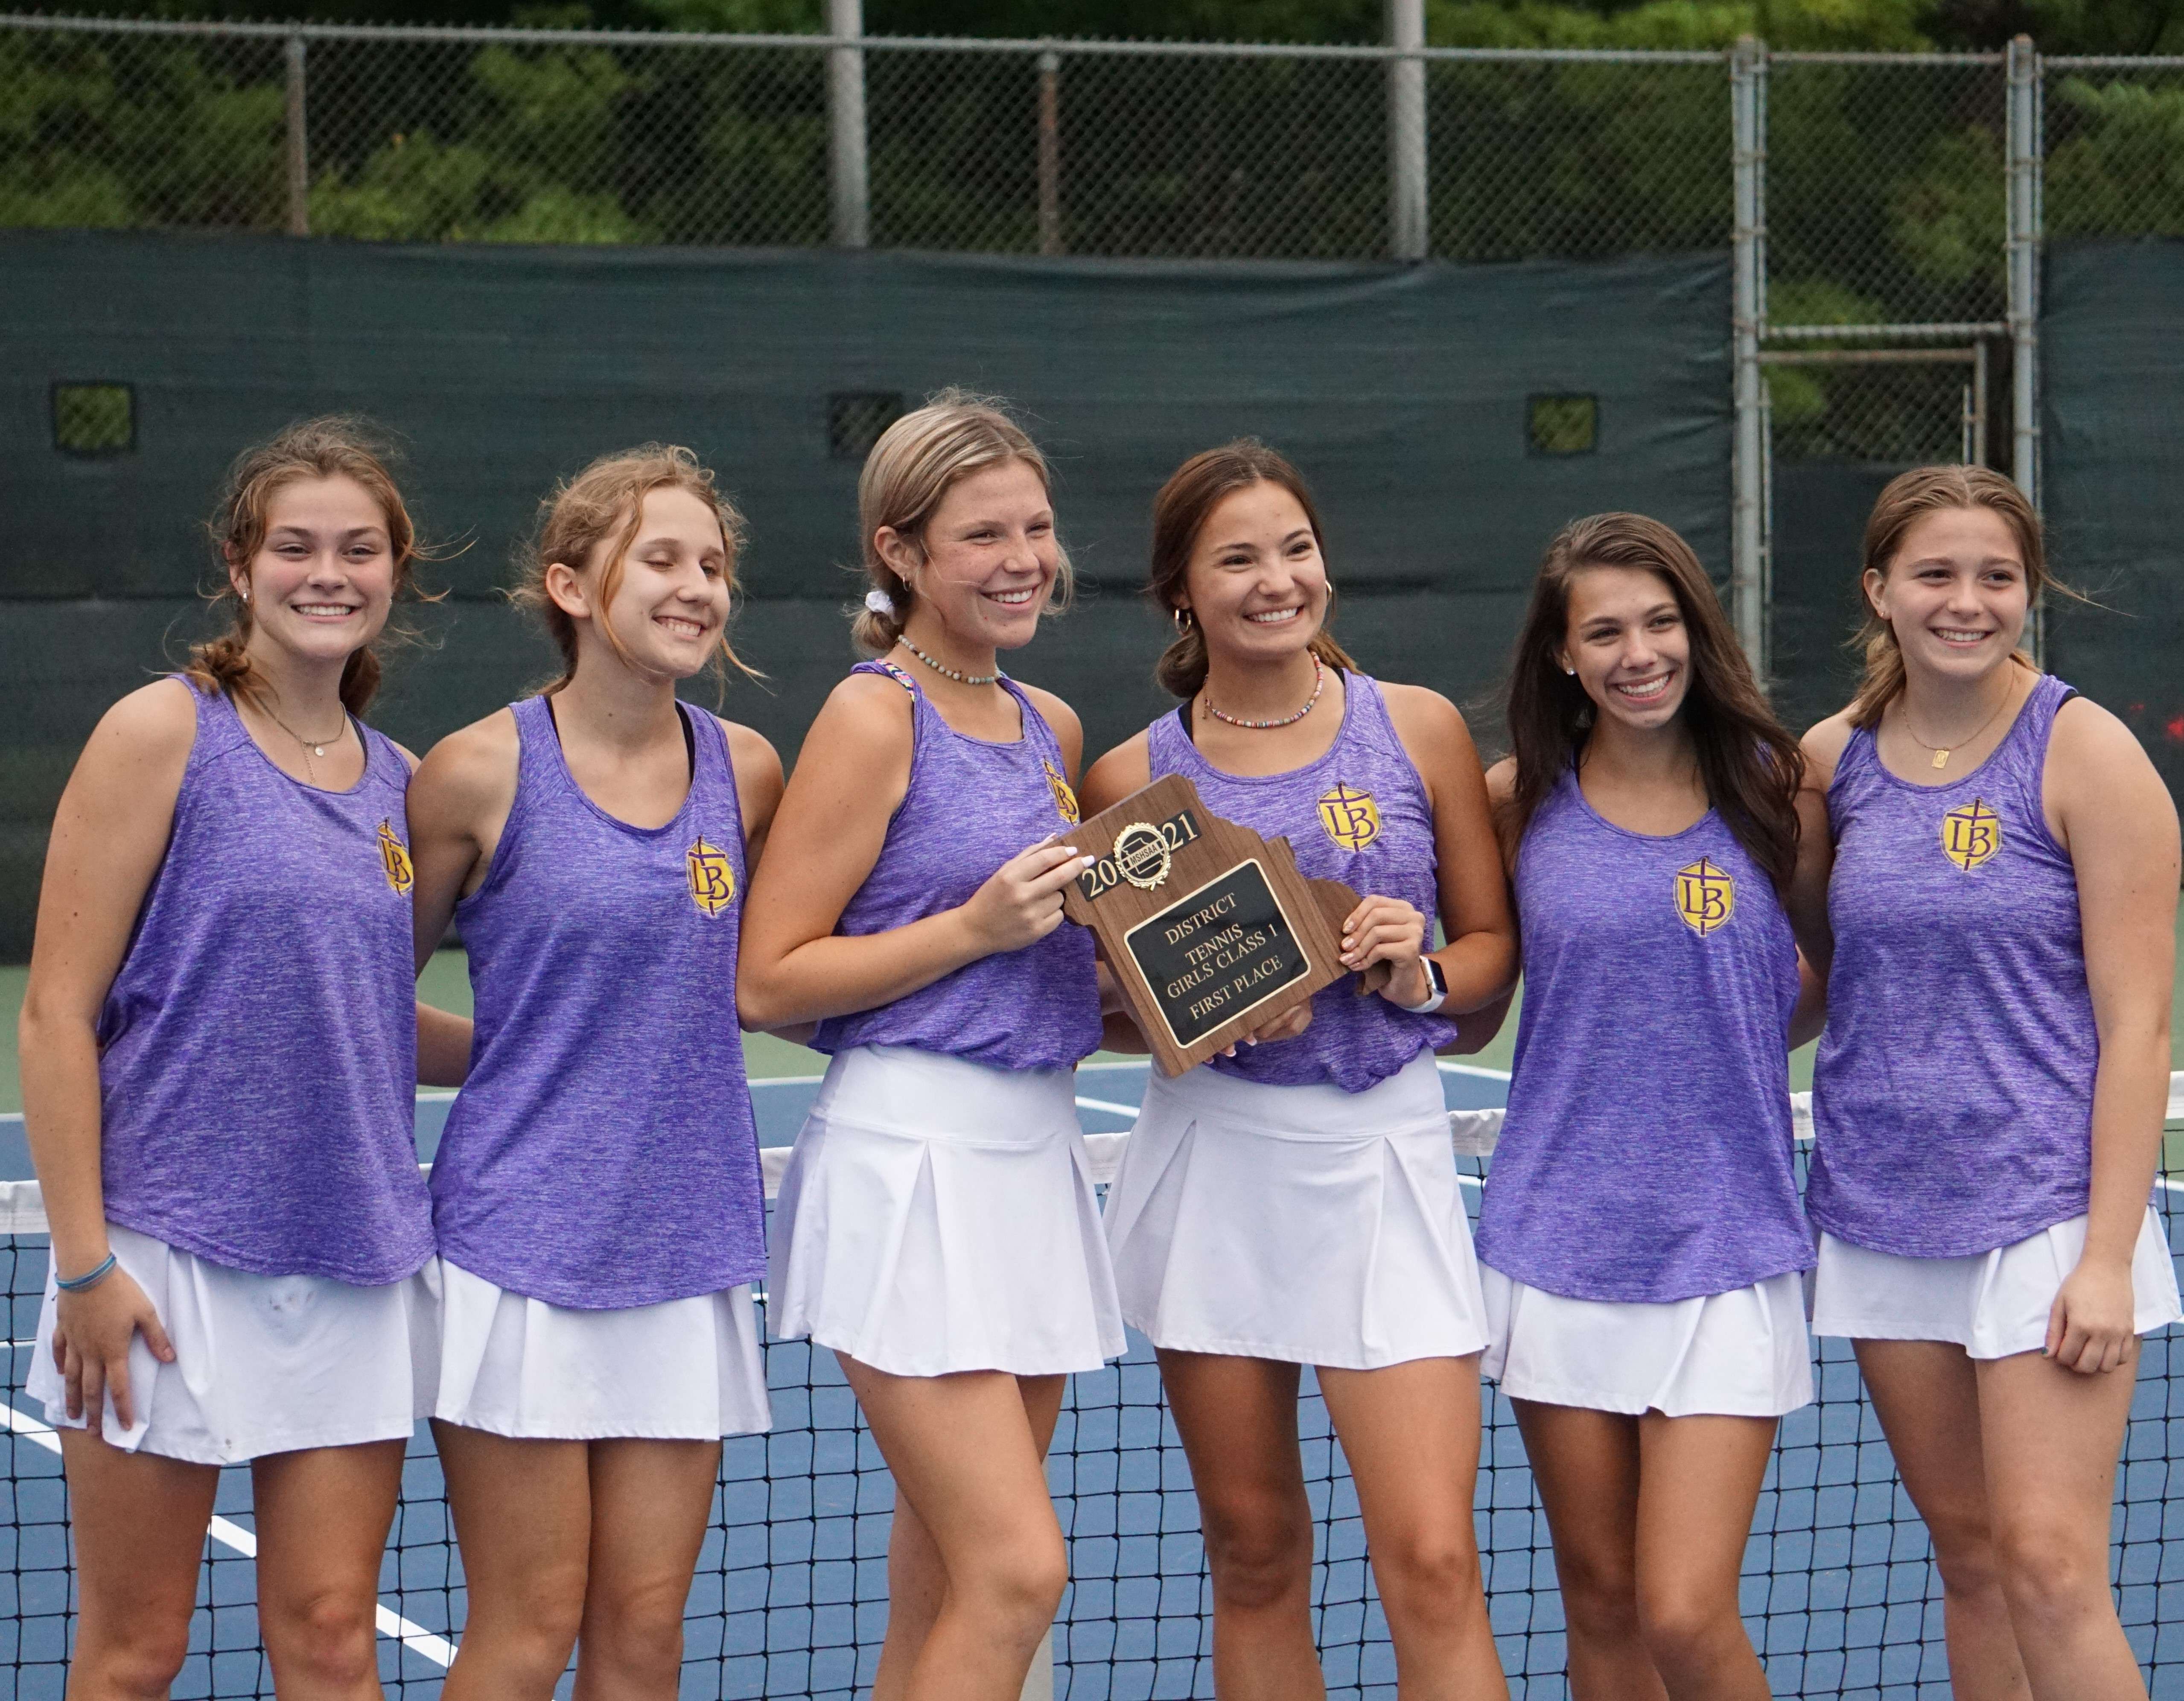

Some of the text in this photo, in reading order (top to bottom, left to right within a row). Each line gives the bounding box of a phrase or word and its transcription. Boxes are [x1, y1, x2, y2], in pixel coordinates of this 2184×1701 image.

[1162, 814, 1198, 851] 21
[1325, 805, 1375, 840] LB
[1949, 820, 1991, 858] LB
[1129, 845, 1158, 866] MSHSAA
[692, 860, 730, 900] LB
[1683, 879, 1725, 920] LB
[1164, 892, 1237, 945] DISTRICT
[1167, 923, 1278, 998] GIRLS CLASS 1
[1184, 923, 1243, 966] TENNIS
[1189, 955, 1283, 1020] FIRST PLACE
